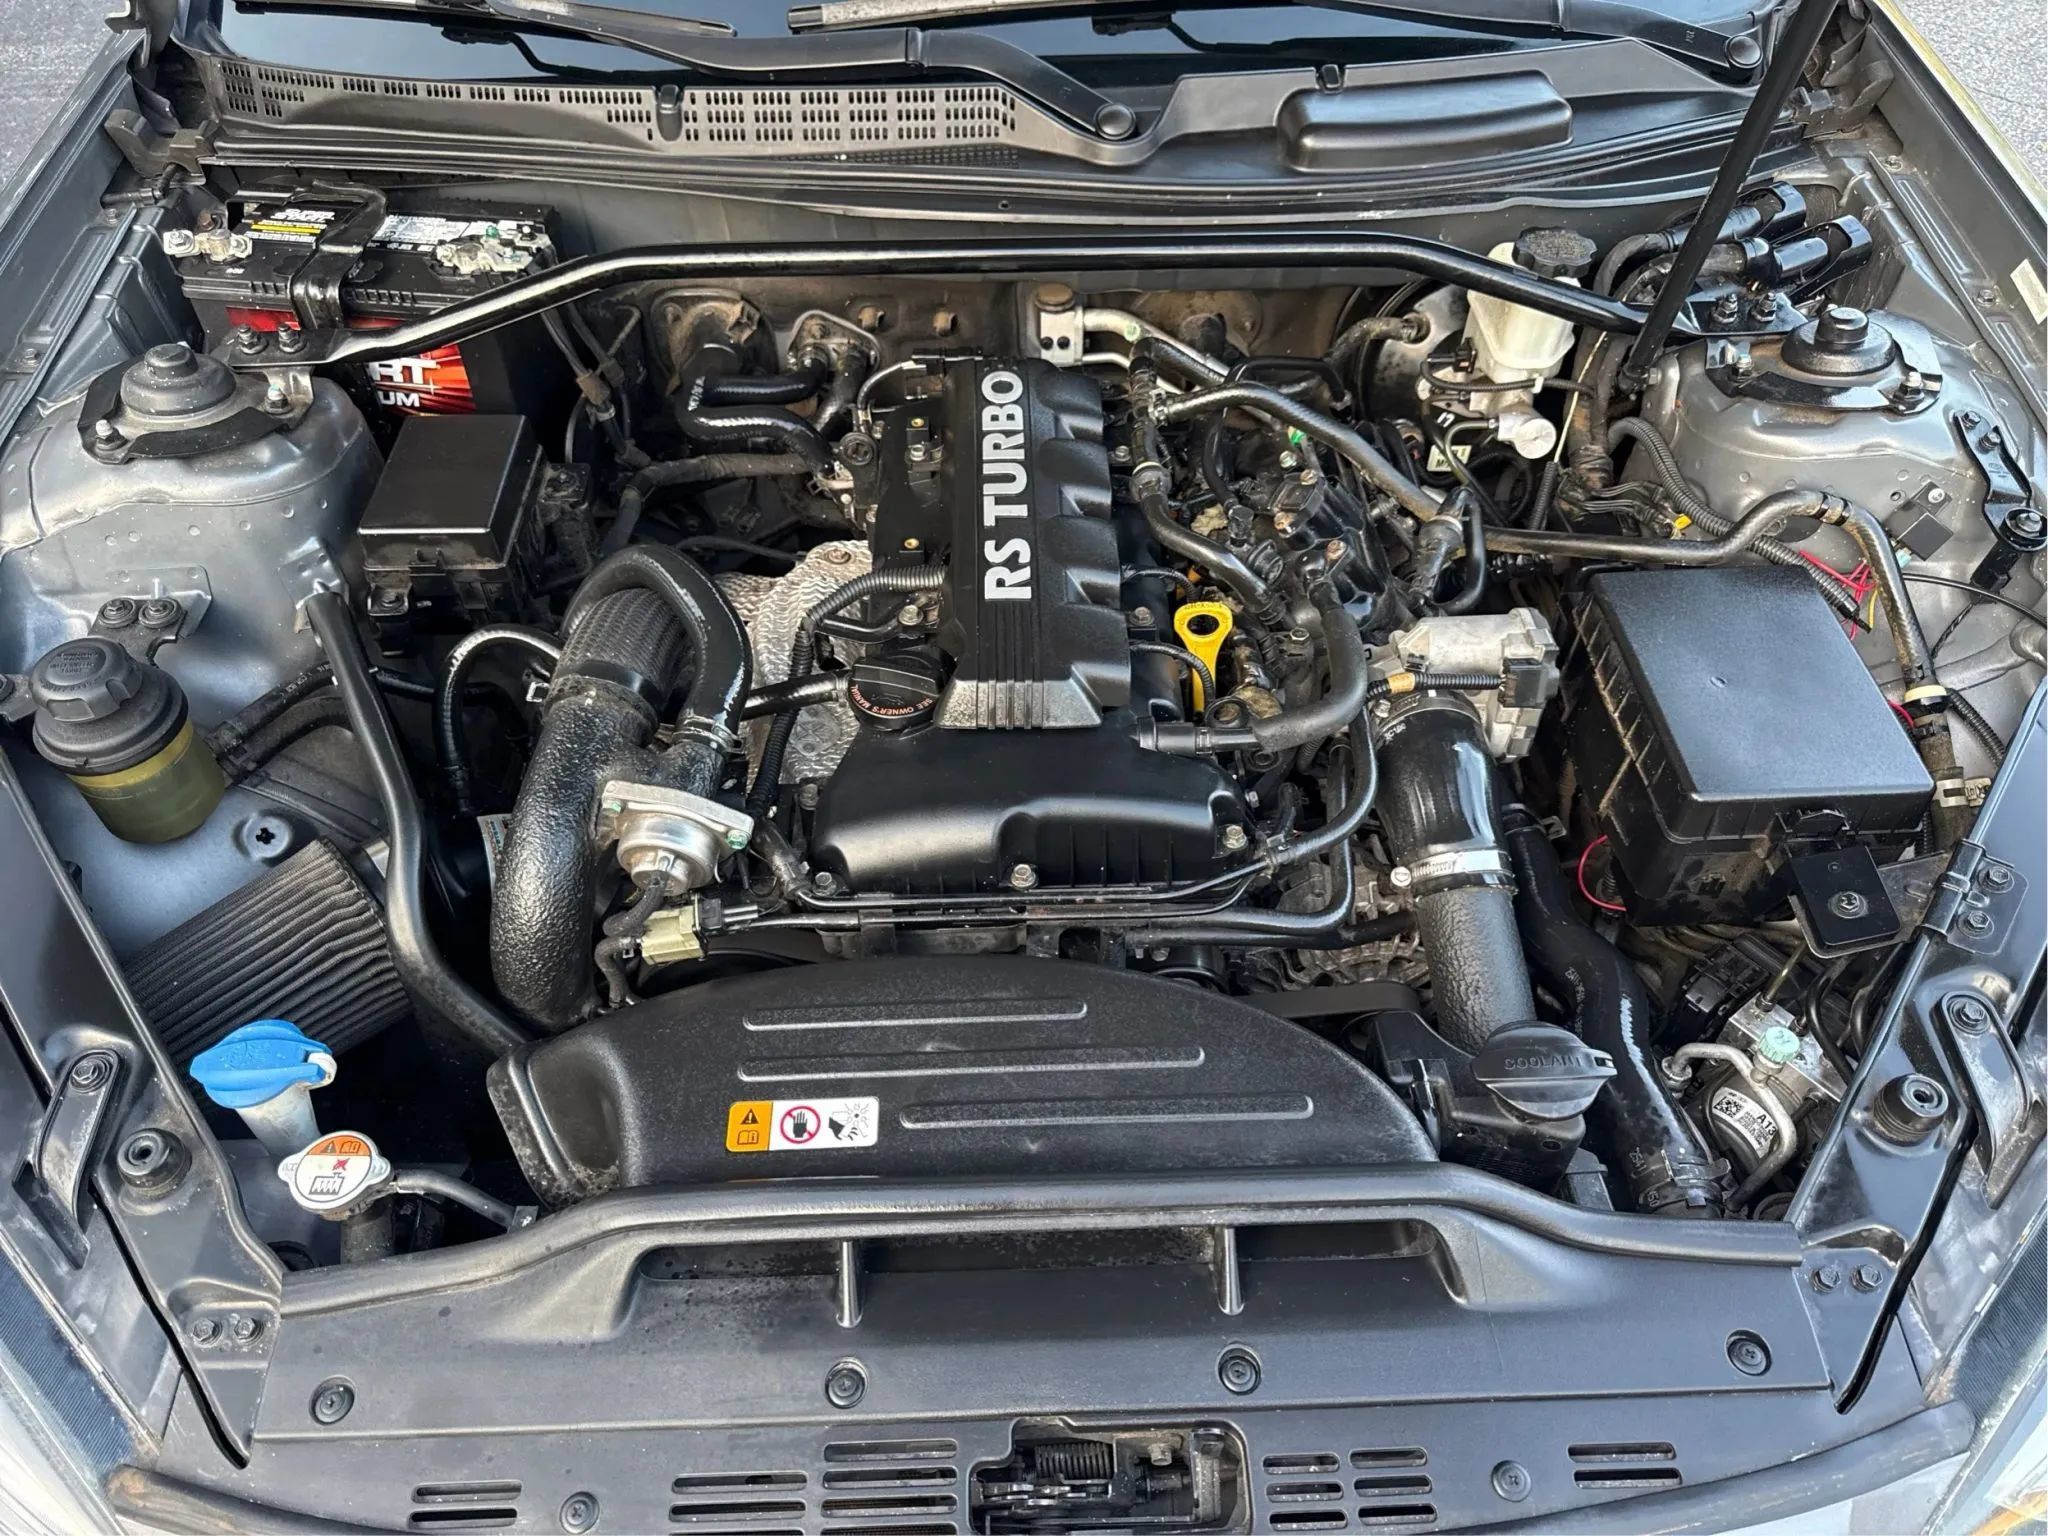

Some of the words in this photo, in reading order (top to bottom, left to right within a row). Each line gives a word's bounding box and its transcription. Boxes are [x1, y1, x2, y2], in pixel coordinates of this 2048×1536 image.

[377, 391, 420, 407] UM
[981, 370, 1028, 527] TURBO
[984, 537, 1032, 600] RS
[872, 705, 915, 716] OWNER'S
[915, 698, 934, 710] SEE
[1504, 1055, 1582, 1071] COOLANT
[1756, 1113, 1778, 1137] A13
